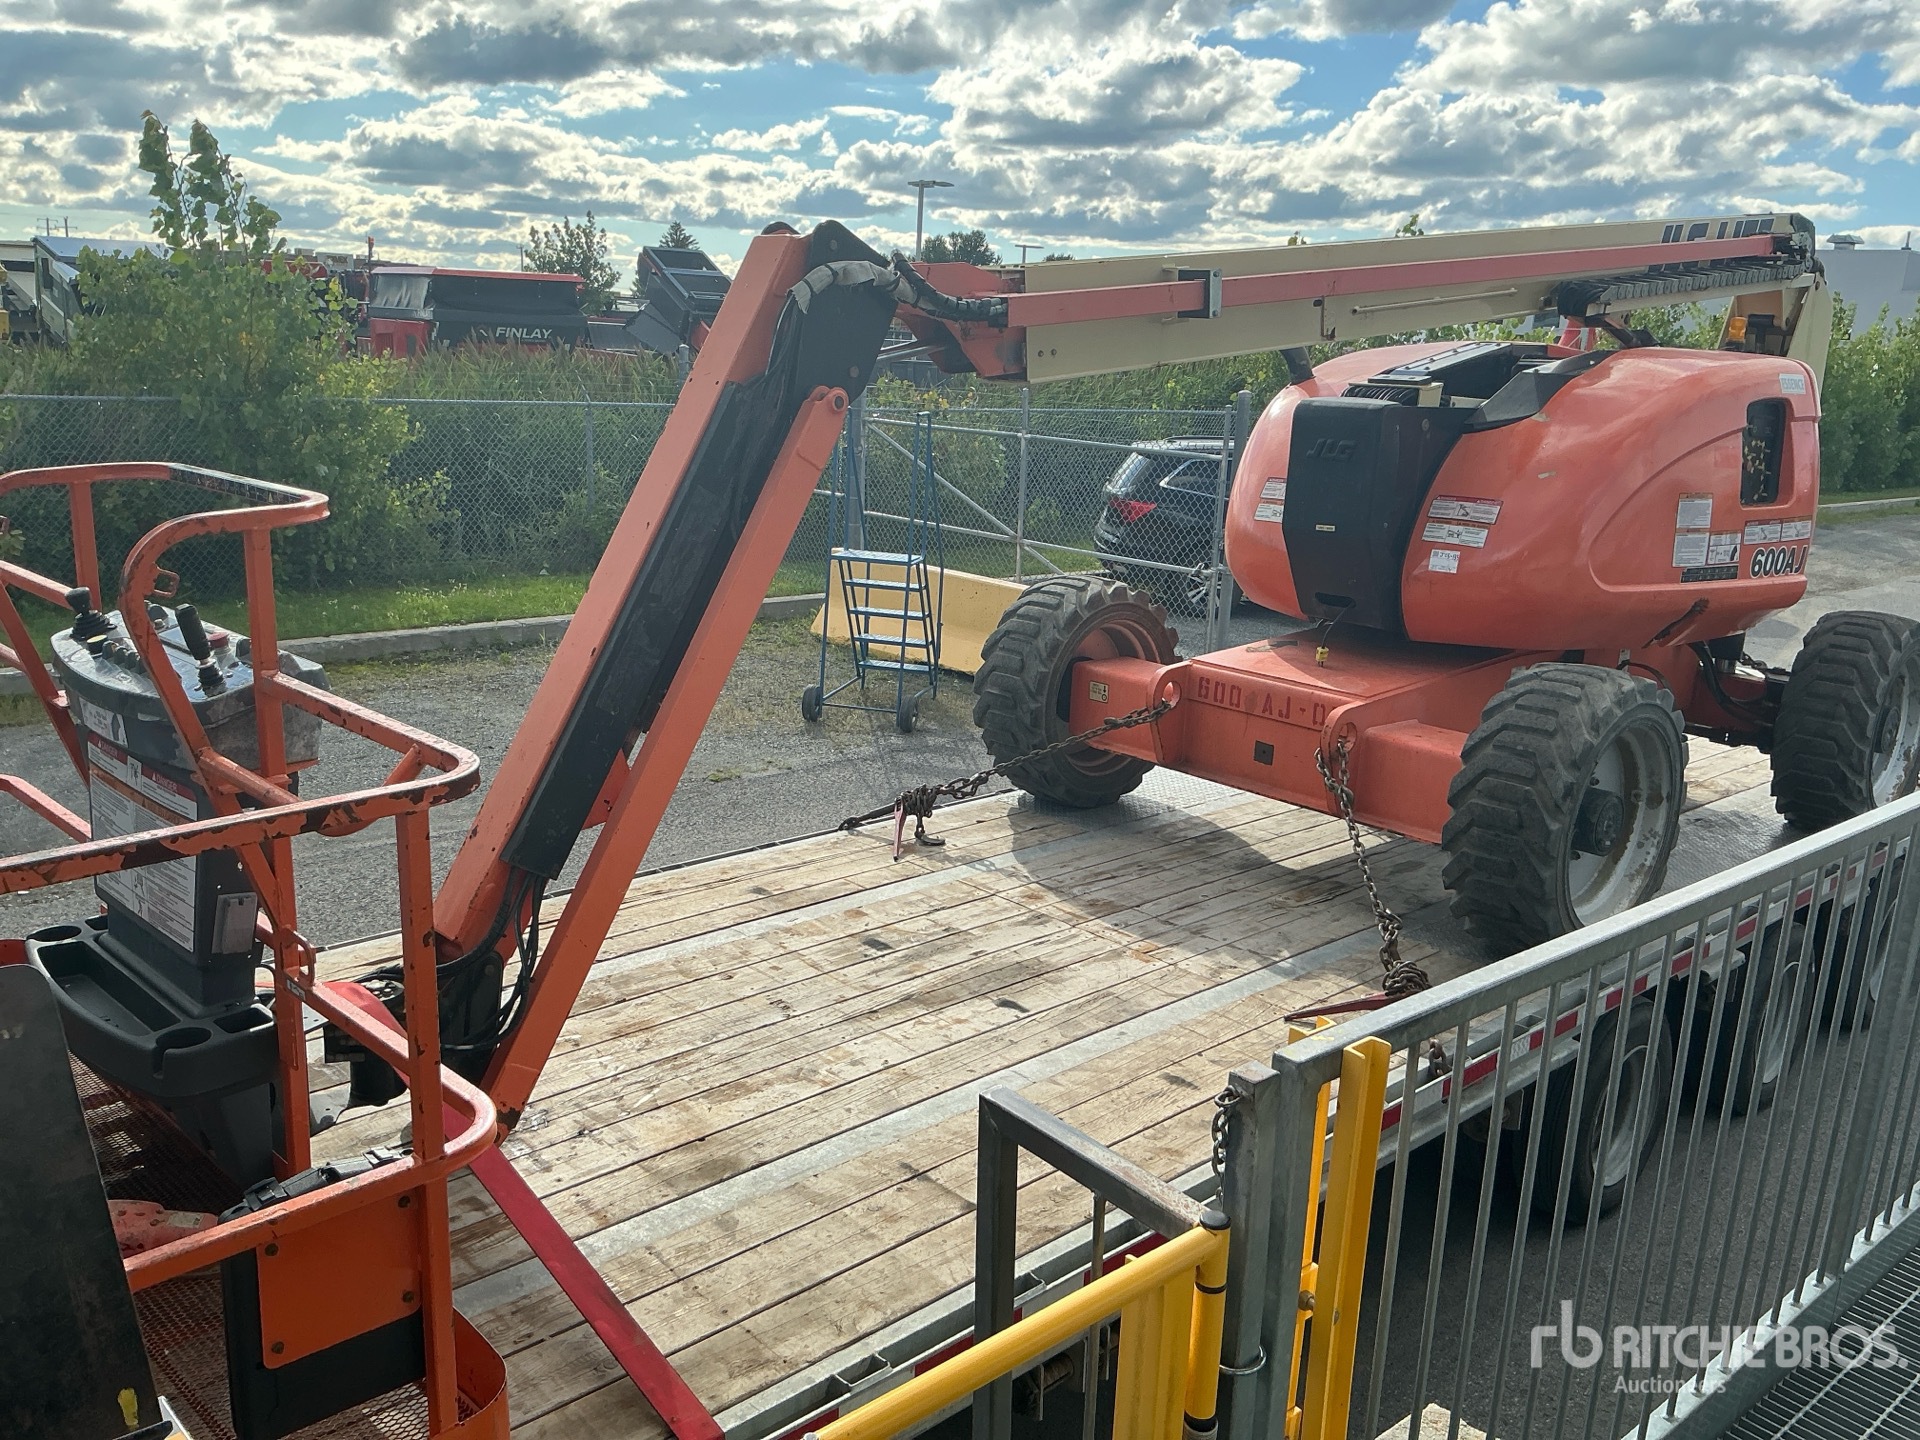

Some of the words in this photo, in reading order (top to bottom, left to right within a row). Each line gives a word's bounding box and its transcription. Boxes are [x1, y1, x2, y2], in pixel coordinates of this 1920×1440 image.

[496, 327, 552, 339] FINLAY
[1305, 438, 1358, 459] JLG
[1750, 545, 1809, 579] 600AJ
[1197, 676, 1242, 709] 600
